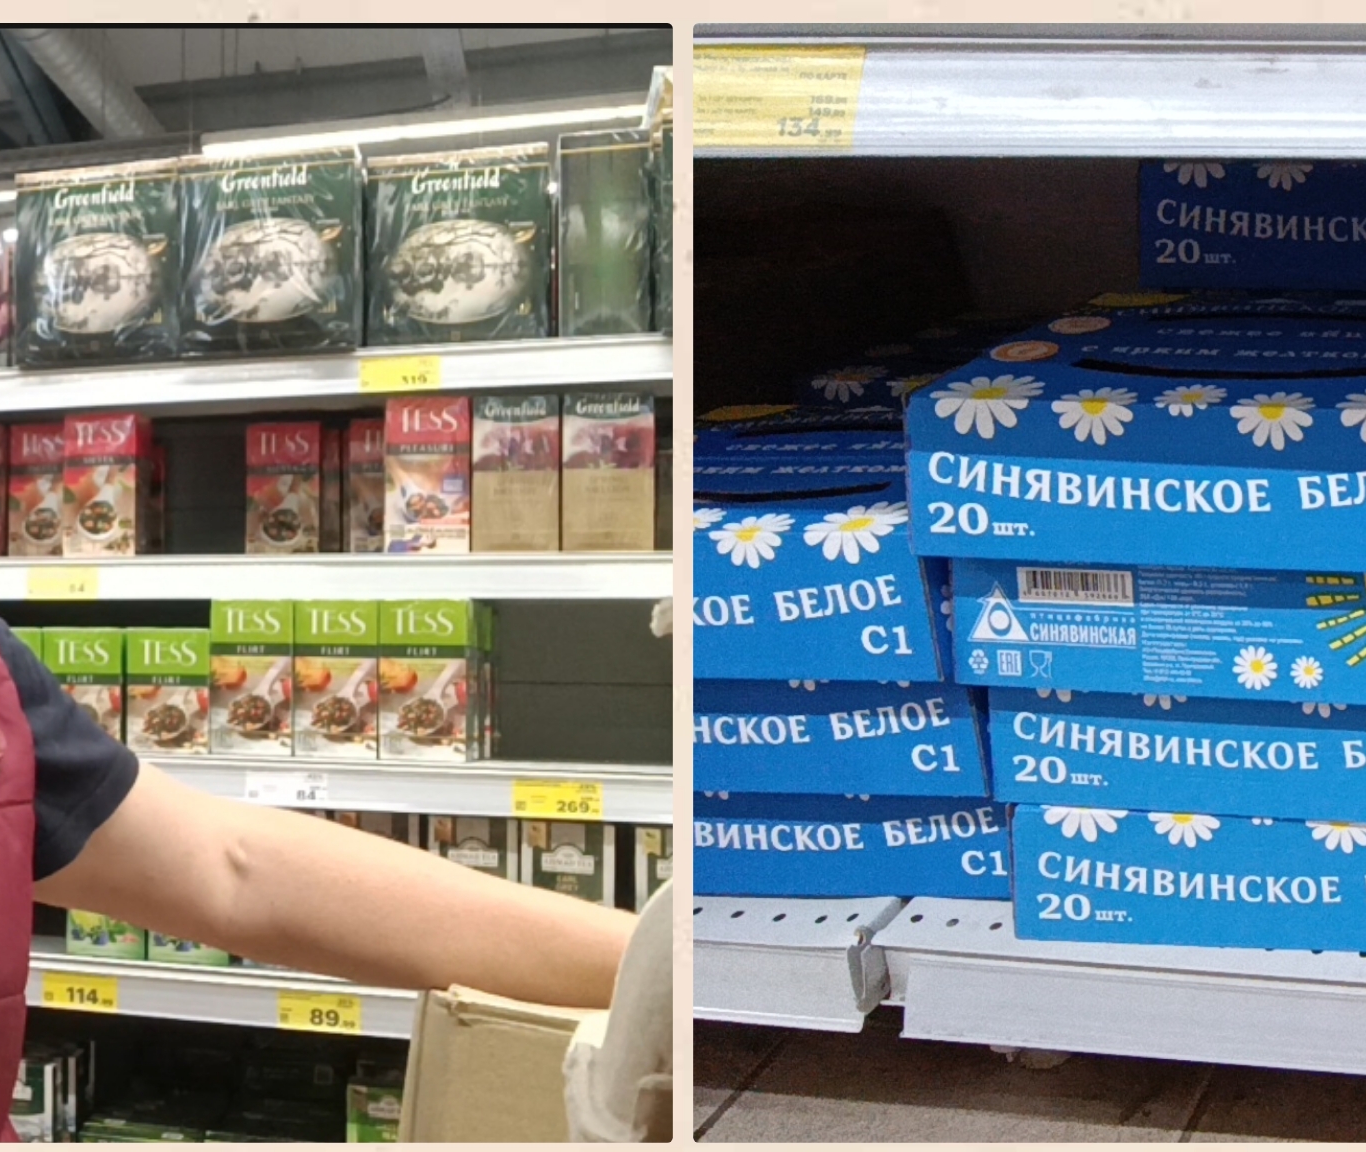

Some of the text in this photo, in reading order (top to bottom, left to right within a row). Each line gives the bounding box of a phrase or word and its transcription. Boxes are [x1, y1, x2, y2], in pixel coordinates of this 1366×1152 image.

[221, 167, 308, 193] Greenfield
[412, 167, 501, 195] Greenfield
[53, 187, 136, 211] Greenfield
[401, 406, 459, 434] TESS
[484, 400, 547, 419] Greenfield
[576, 398, 640, 416] Greenfield
[75, 414, 135, 448] TESS
[260, 430, 311, 457] TESS
[927, 450, 1272, 515] СИНЯВИНСКОЕ
[773, 573, 903, 624] БЕЛОЕ
[224, 605, 282, 635] TESS
[310, 606, 368, 635] TESS
[396, 606, 455, 636] TESS
[1029, 623, 1137, 646] СИНЯВИНСКАЯ
[55, 638, 110, 667] TESS
[141, 639, 199, 668] TESS
[236, 645, 265, 655] FLIRT
[321, 645, 351, 656] FLIRT
[406, 646, 438, 657] FLIRT
[829, 697, 952, 742] БЕЛОЕ
[1013, 711, 1320, 771] СИНЯВИНСКОЕ
[694, 805, 1000, 852] ВИНСКОЕ БЕЛОЕ
[1036, 850, 1342, 904] СИНЯВИНСКОЕ
